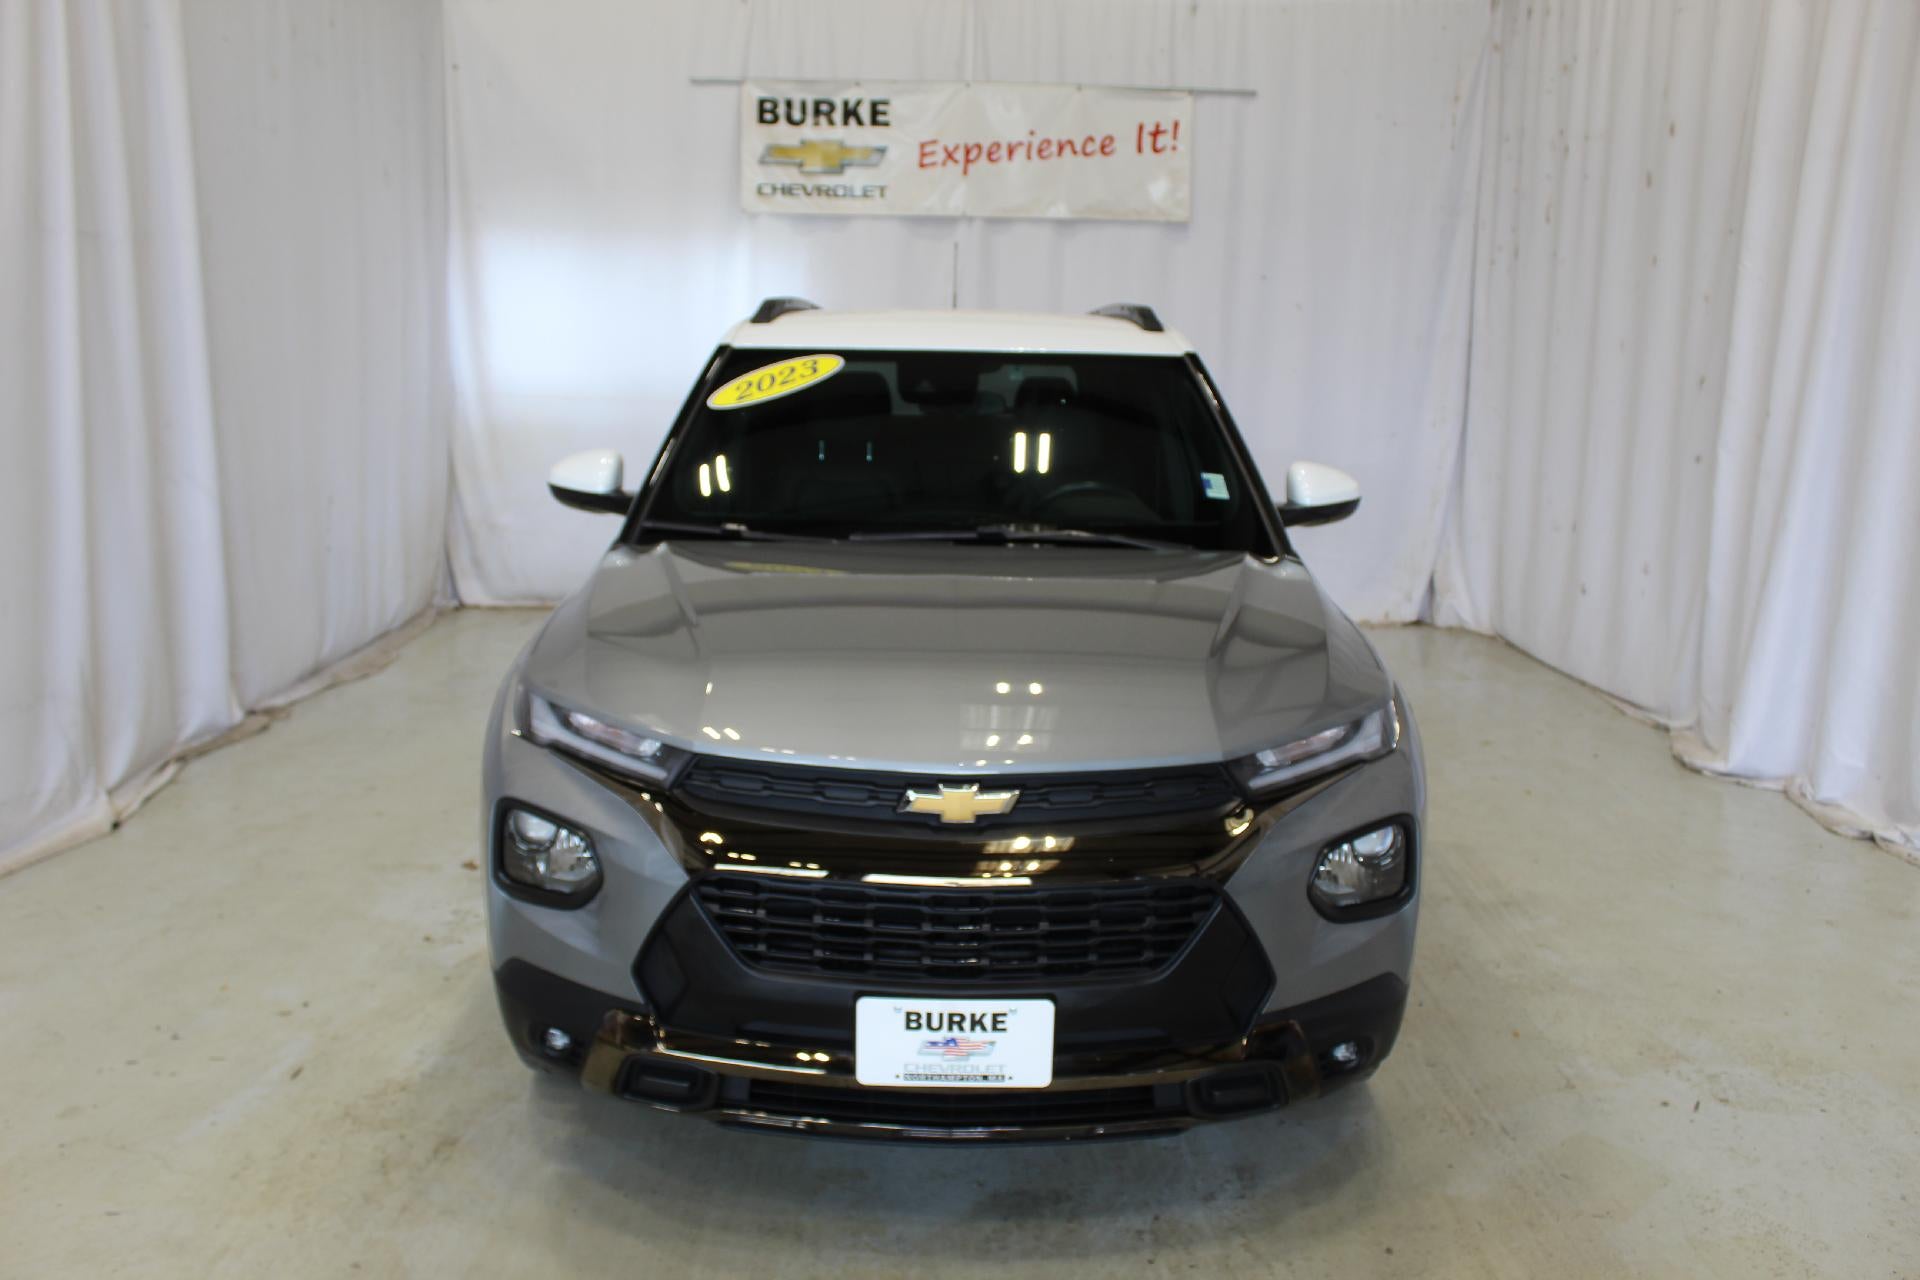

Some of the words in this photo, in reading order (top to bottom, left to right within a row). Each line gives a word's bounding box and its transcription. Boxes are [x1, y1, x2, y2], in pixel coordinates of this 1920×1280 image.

[756, 97, 891, 127] BURKE
[918, 131, 1115, 176] Experience
[1136, 120, 1181, 155] It!
[756, 182, 888, 199] CHEVROLET
[735, 359, 818, 400] 2023
[904, 1011, 1009, 1033] BURKE
[903, 1063, 1006, 1074] CHEVROLET
